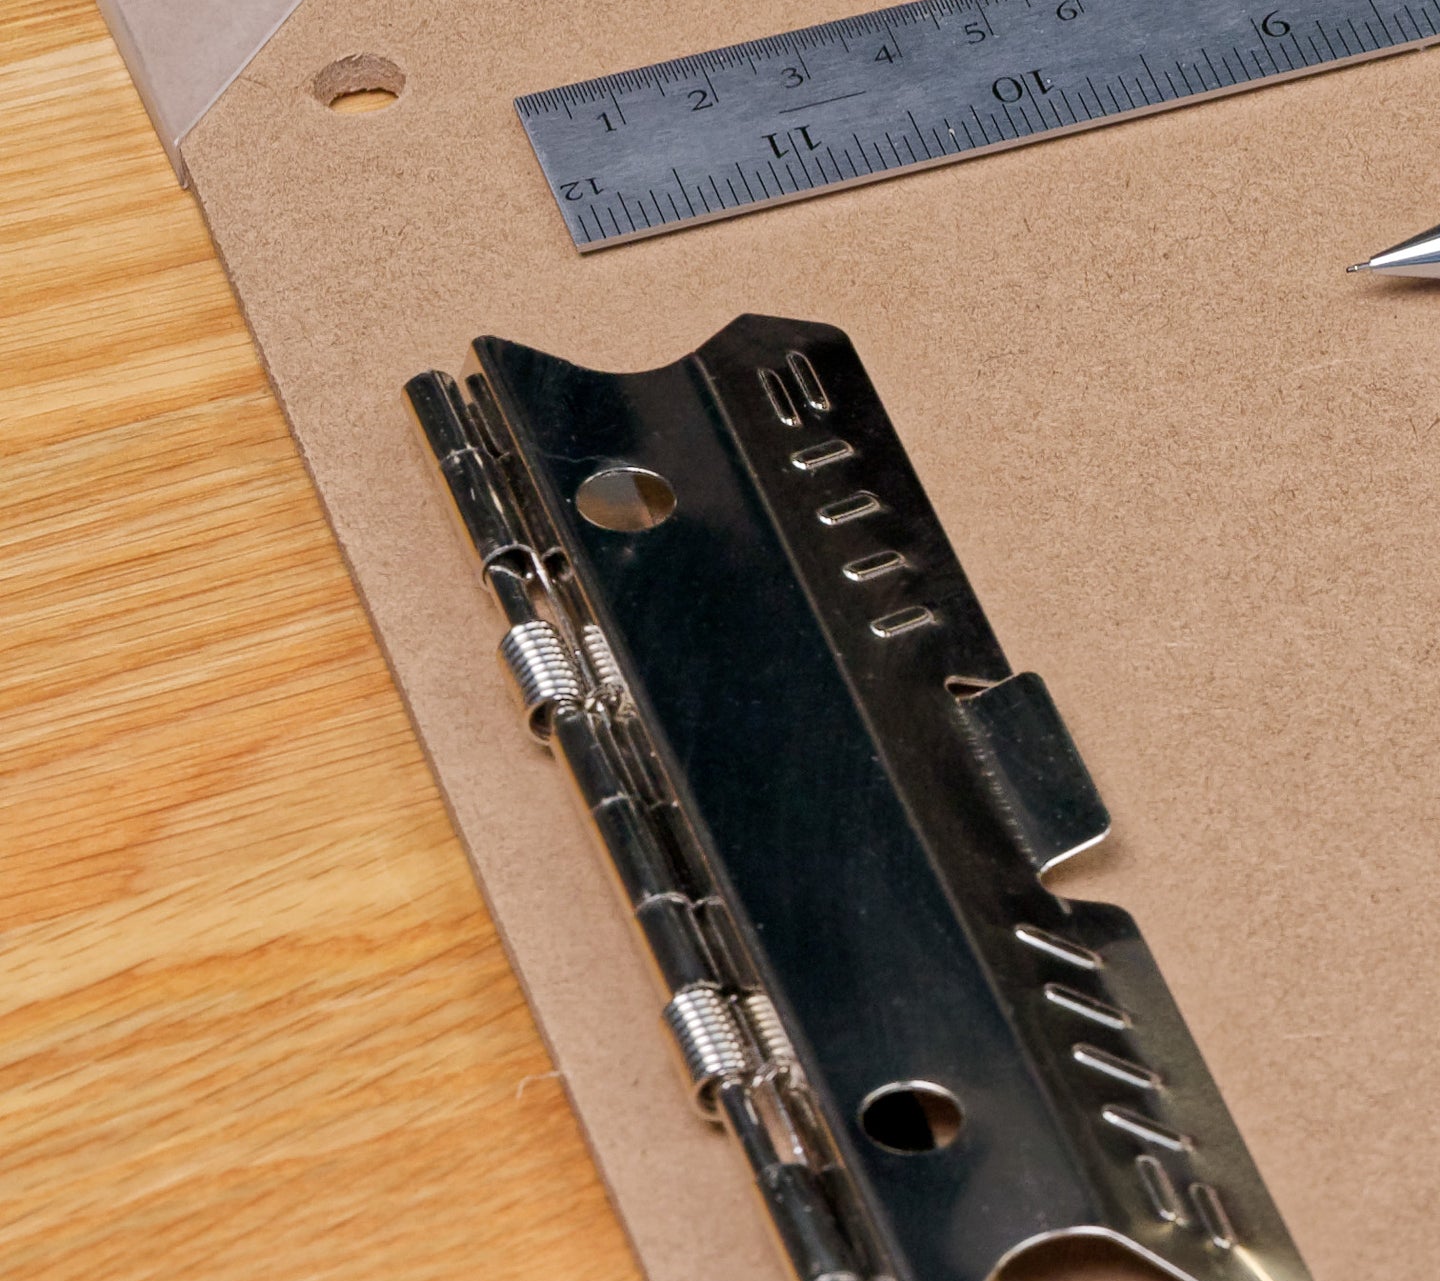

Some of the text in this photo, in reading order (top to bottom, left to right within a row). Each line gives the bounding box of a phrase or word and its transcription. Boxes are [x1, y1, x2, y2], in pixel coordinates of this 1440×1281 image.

[1261, 9, 1291, 39] 9
[597, 112, 619, 134] 1
[689, 89, 715, 111] 2
[780, 66, 805, 89] 3
[873, 43, 897, 66] 4
[963, 21, 988, 45] 5
[991, 68, 1056, 104] 10
[761, 125, 823, 160] 11
[562, 176, 606, 202] 12
